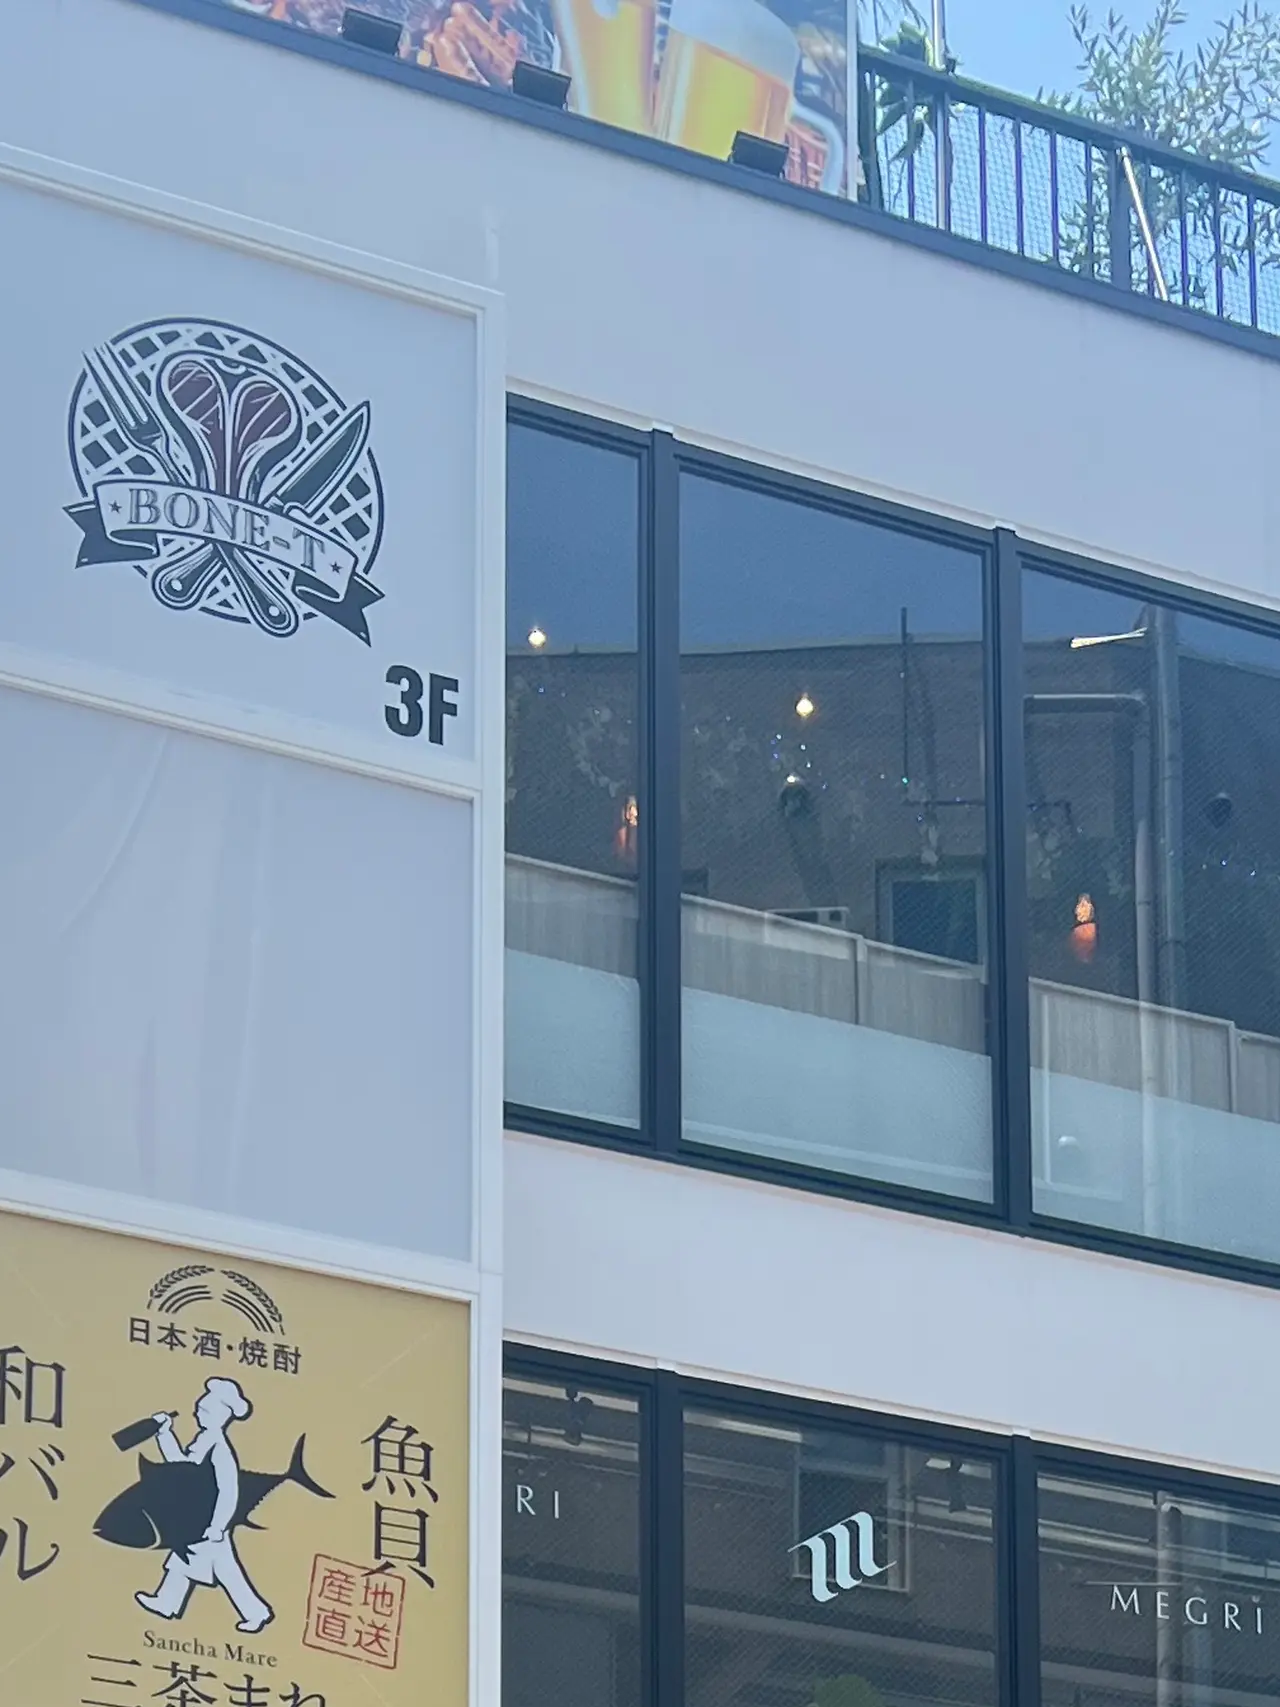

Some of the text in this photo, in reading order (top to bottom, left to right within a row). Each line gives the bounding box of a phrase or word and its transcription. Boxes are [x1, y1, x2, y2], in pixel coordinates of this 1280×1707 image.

[127, 488, 326, 574] BONE-T
[384, 665, 459, 745] 3F
[129, 1317, 302, 1375] 日本酒・焼酎
[360, 1414, 439, 1589] 魚貝
[1110, 1584, 1265, 1635] MEGRI
[143, 1630, 278, 1669] Sancha Mare
